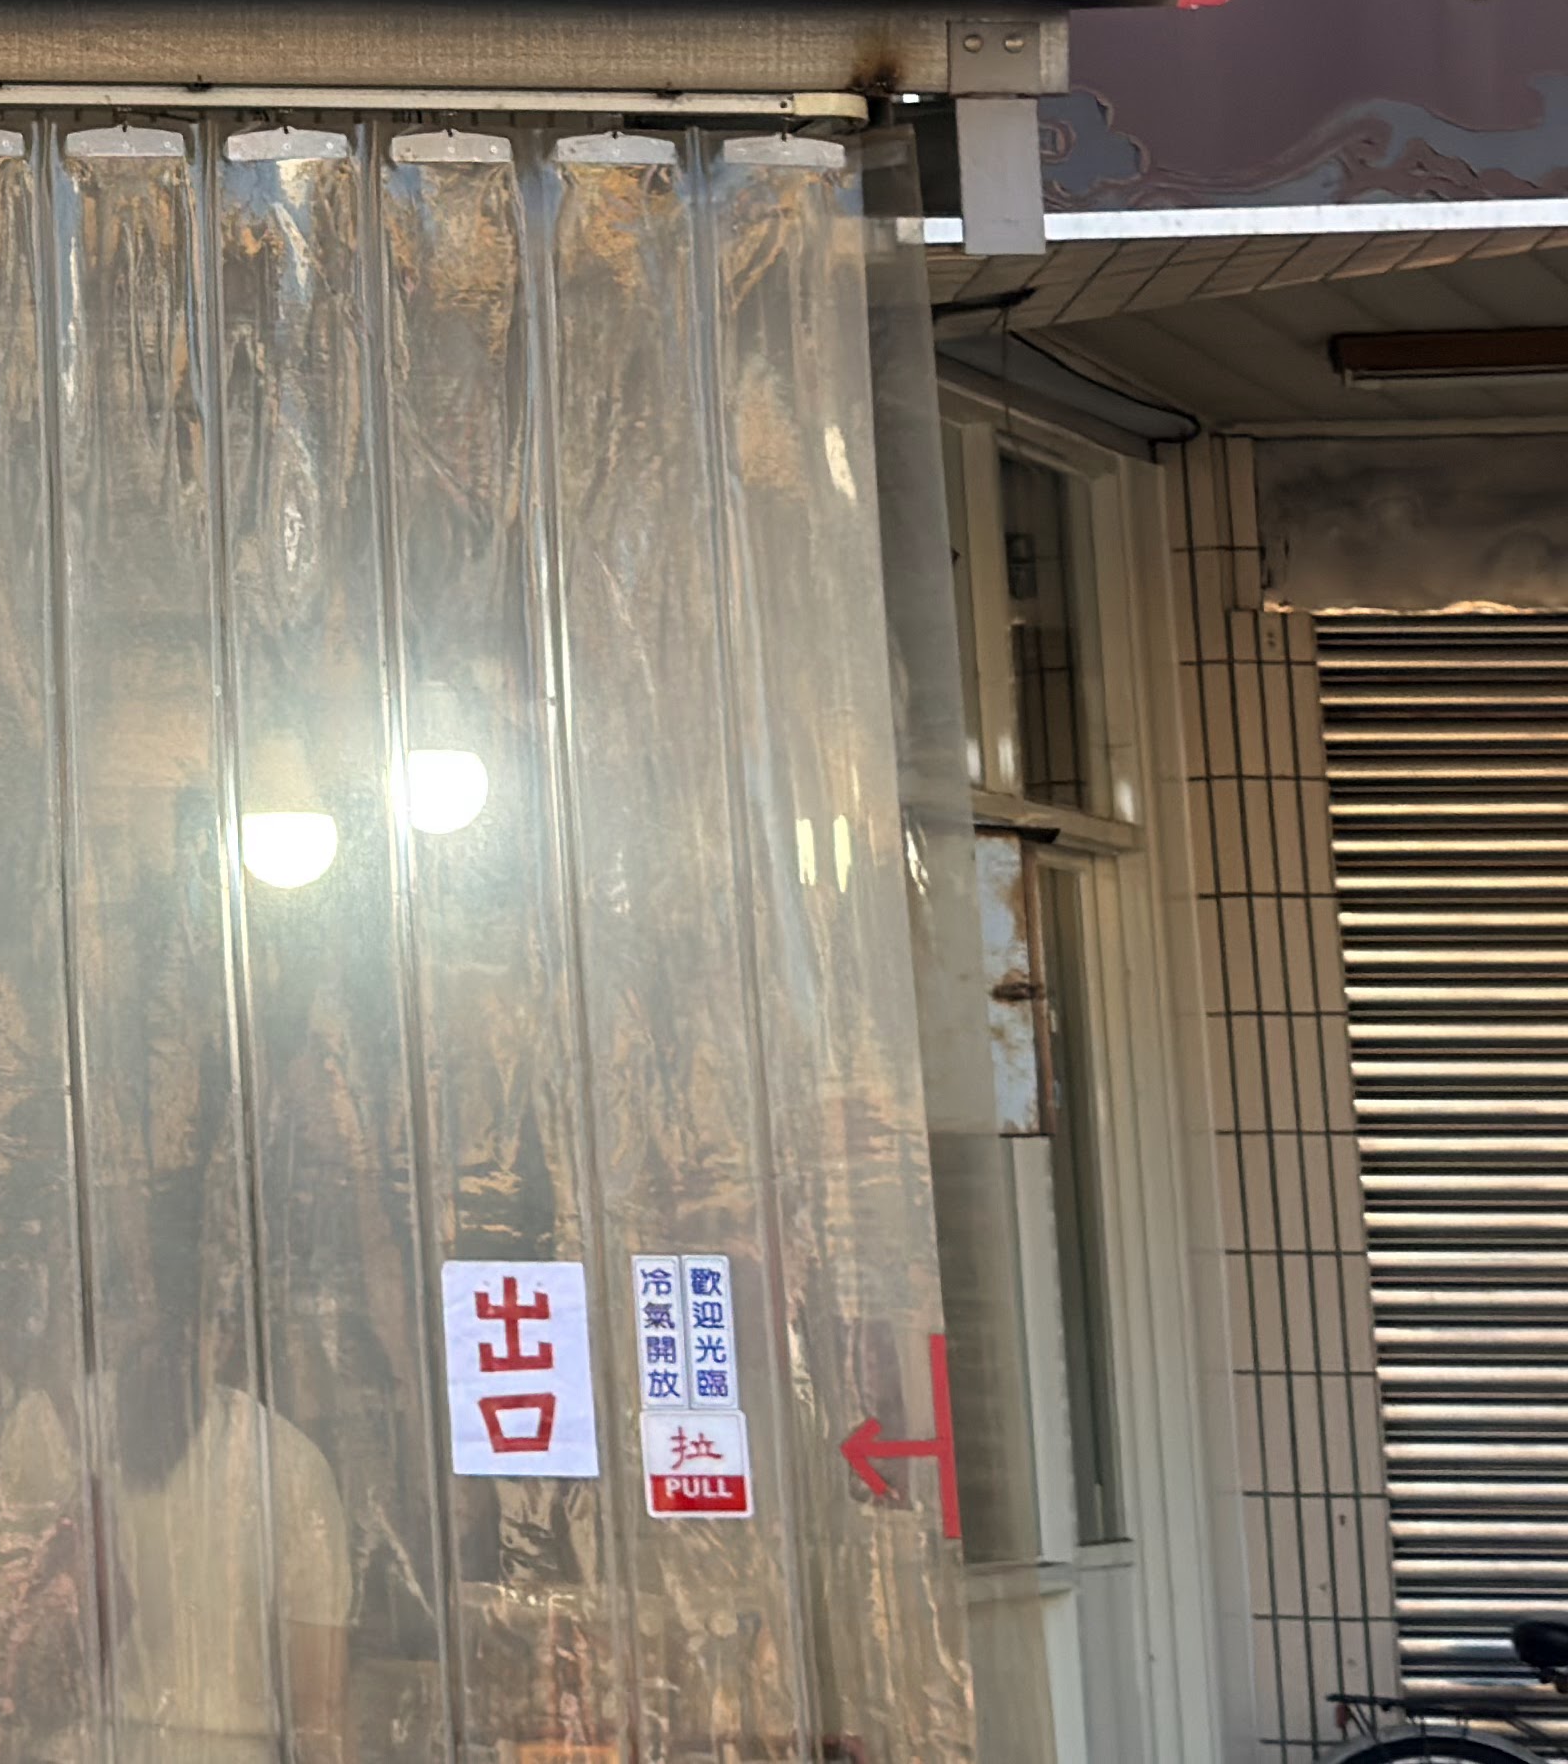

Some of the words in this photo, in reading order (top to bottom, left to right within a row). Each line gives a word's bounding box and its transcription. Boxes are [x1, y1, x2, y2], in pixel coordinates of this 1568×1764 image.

[474, 1275, 557, 1453] 出口
[640, 1267, 681, 1400] 冷氣開放
[689, 1267, 730, 1399] 歡迎光臨
[664, 1476, 733, 1500] PULL
[670, 1426, 724, 1470] 拉
